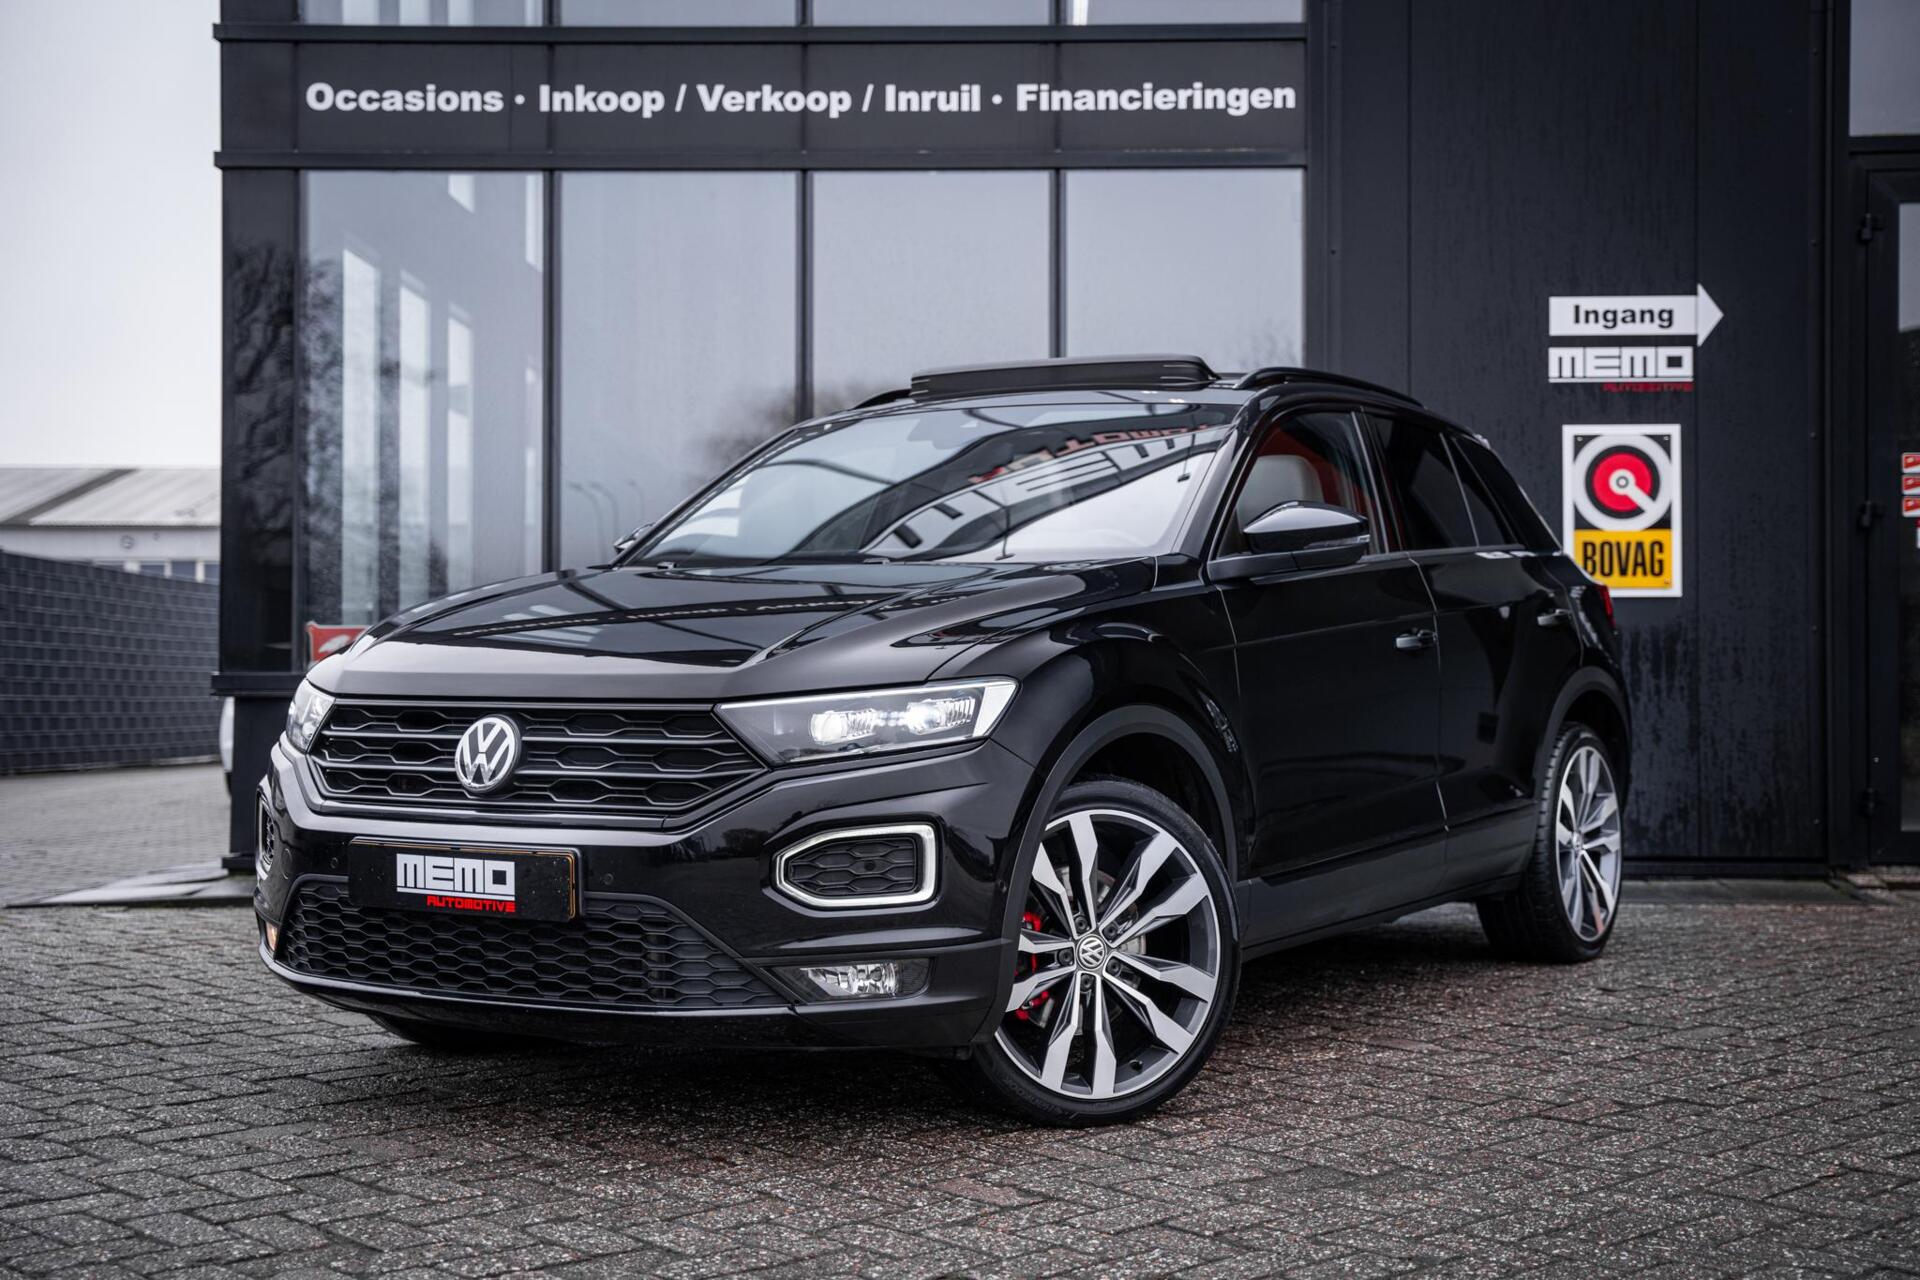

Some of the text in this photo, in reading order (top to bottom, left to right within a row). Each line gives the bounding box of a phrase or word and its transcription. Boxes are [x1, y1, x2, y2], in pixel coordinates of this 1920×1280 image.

[306, 82, 504, 113] Occasions
[539, 84, 665, 119] Inkoop
[695, 83, 852, 119] Verkoop
[885, 83, 981, 113] Inruil
[1016, 81, 1296, 117] Financieringen
[1573, 304, 1674, 329] Ingang
[1548, 347, 1693, 380] MEMO
[1582, 541, 1664, 577] BOVAG
[396, 853, 516, 898] MEMO
[426, 895, 516, 913] AUTOMOTIVE
